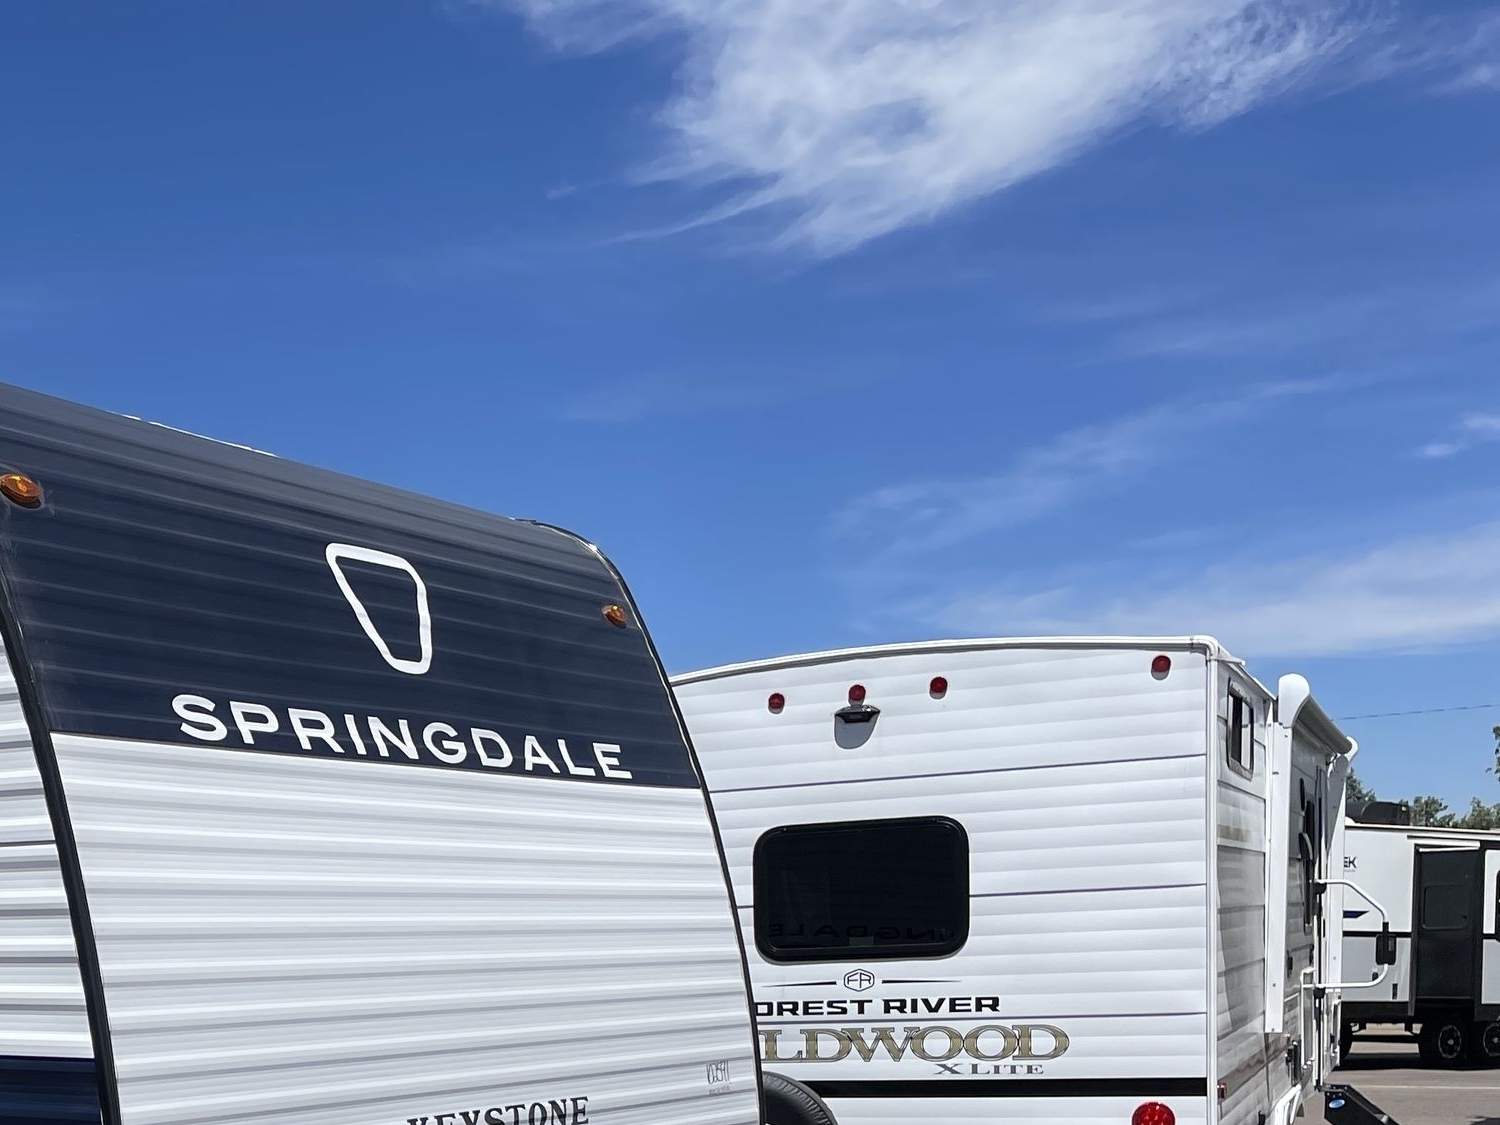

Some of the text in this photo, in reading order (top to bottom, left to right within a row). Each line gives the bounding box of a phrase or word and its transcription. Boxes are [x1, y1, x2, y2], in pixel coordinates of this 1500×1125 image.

[172, 694, 633, 779] SPRINGDALE
[754, 996, 1000, 1017] OREST RIVER
[758, 1024, 1070, 1064] LDWOOD
[933, 1063, 1044, 1075] X LITE
